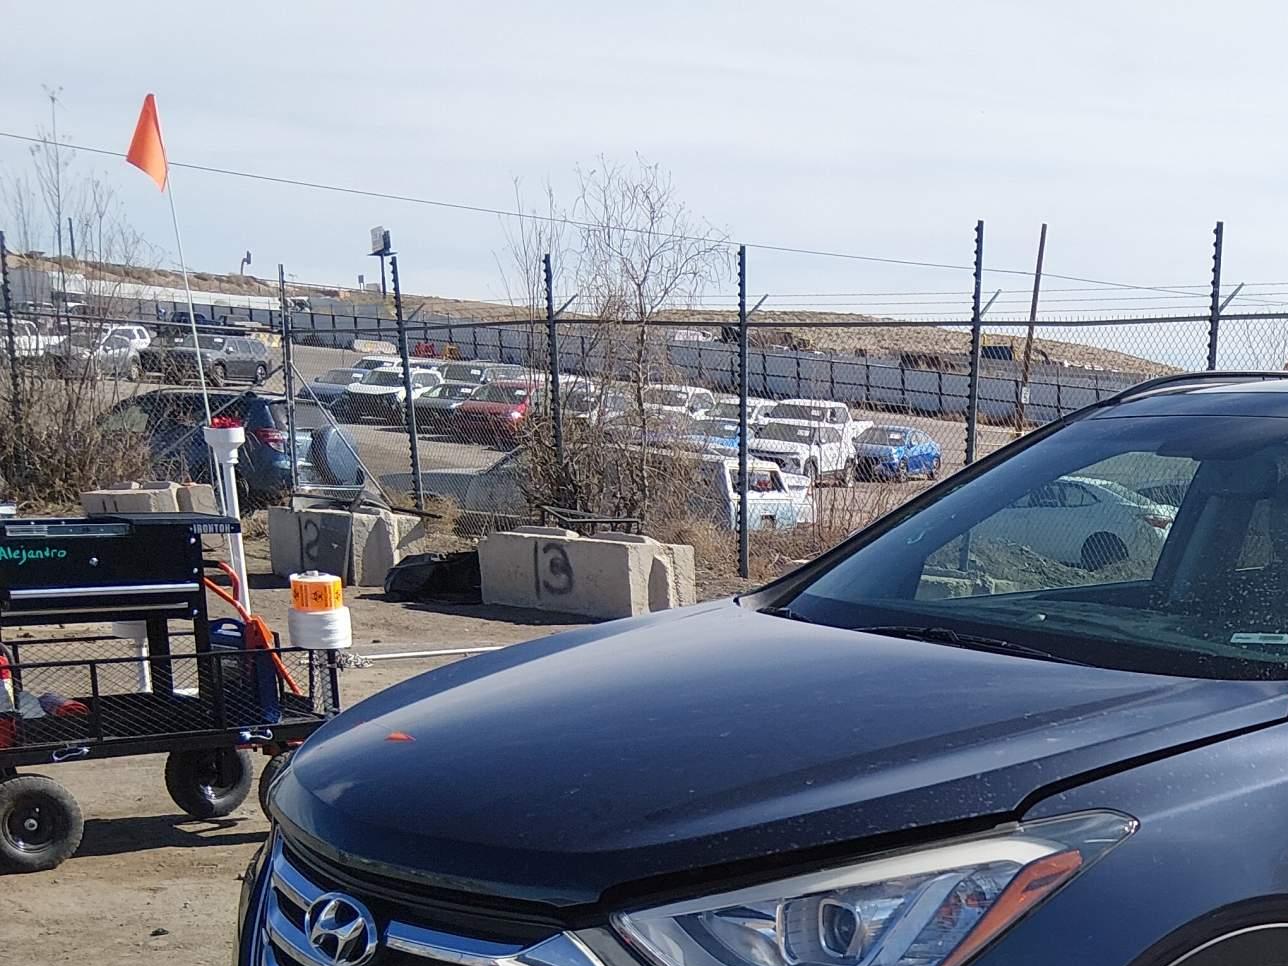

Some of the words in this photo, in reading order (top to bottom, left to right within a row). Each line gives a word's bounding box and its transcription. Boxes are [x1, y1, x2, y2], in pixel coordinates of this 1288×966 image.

[193, 523, 231, 534] IRONTON
[0, 545, 67, 566] Alejandro
[533, 540, 575, 600] 13
